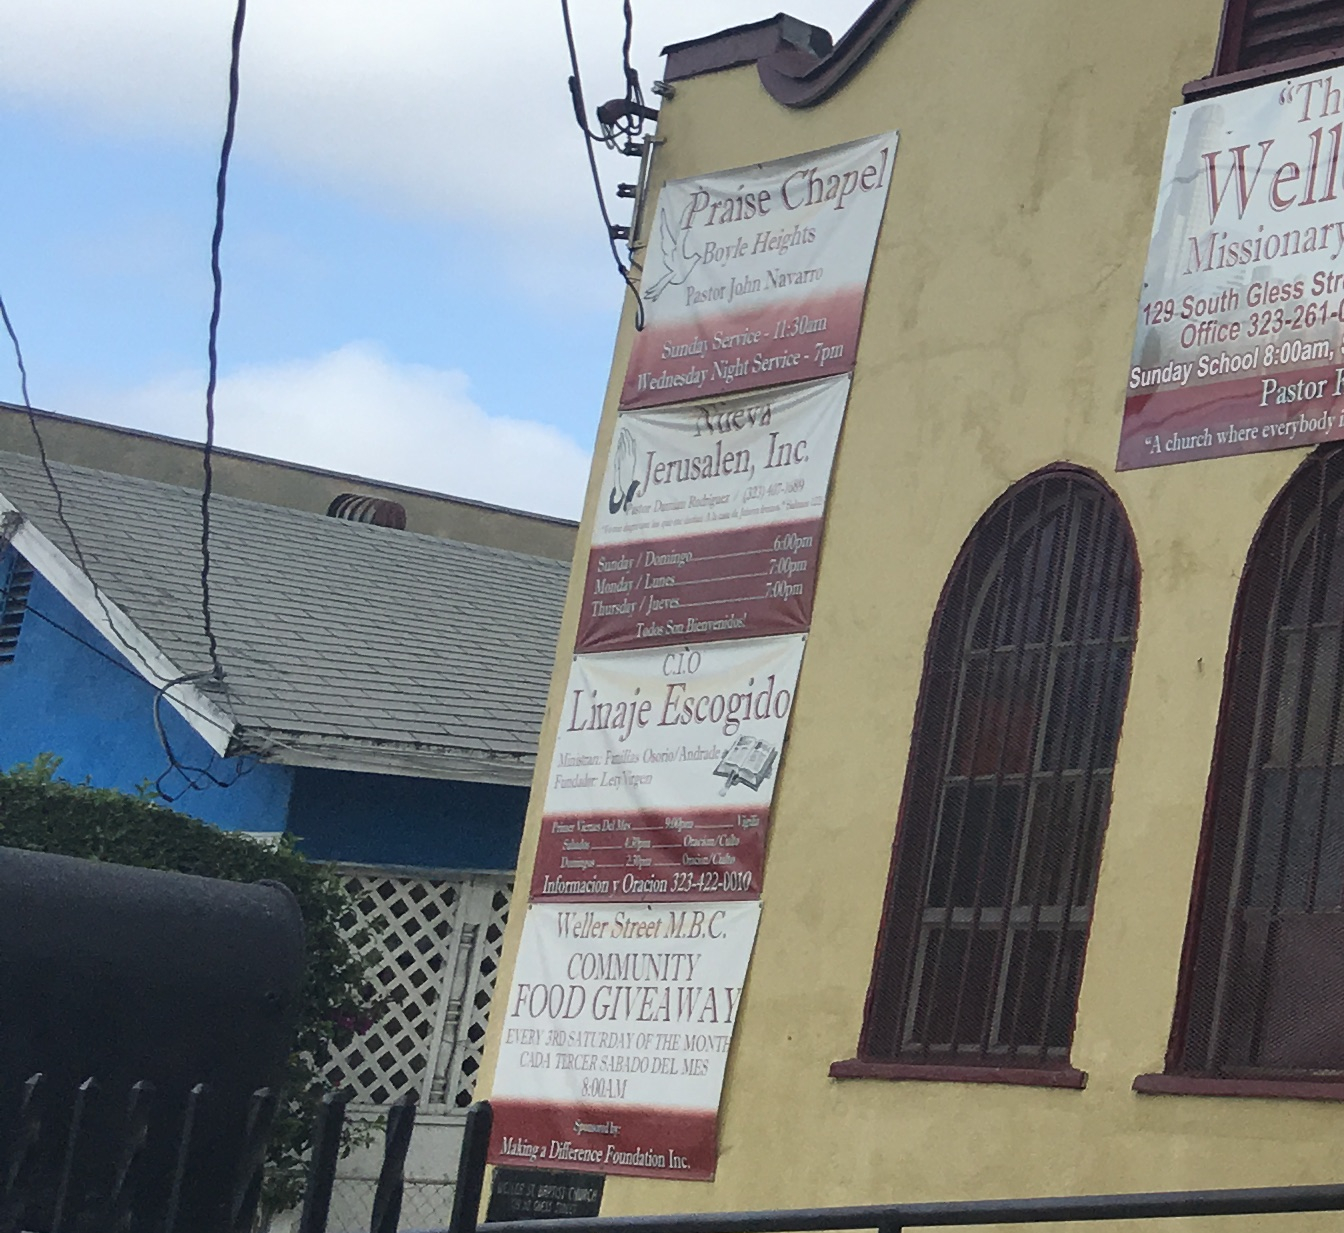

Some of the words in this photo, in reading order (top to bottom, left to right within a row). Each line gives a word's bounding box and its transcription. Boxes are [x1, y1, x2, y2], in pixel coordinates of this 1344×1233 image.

[681, 184, 771, 230] Praise
[781, 147, 889, 211] Chapel
[702, 237, 749, 267] Boyle
[750, 225, 817, 256] Heights
[686, 284, 726, 306] Pastor
[728, 274, 761, 303] John
[764, 266, 824, 290] Navarro
[1143, 298, 1175, 325] 129
[1180, 288, 1239, 320] South
[1246, 280, 1305, 307] Gless
[661, 335, 708, 360] Sunday
[712, 327, 761, 351] Service
[772, 315, 827, 341] 11:30am
[1180, 319, 1241, 348] Office
[637, 365, 708, 392] Wednesday
[710, 357, 750, 384] Night
[750, 350, 801, 376] Service
[814, 342, 845, 366] 7pm
[1129, 358, 1194, 388] Sunday
[1197, 345, 1259, 378] School
[1263, 338, 1335, 367] 8:00am,
[1259, 378, 1329, 407] Pastor
[1165, 428, 1213, 452] church
[1216, 424, 1260, 446] where
[1262, 410, 1336, 440] everybody
[636, 440, 755, 498] Jerusalen,
[763, 431, 810, 471] Inc.
[597, 555, 634, 574] Sunday
[644, 549, 693, 568] Domingo
[773, 533, 813, 554] 6:00pm
[593, 578, 634, 596] Monday
[644, 574, 675, 590] Lunes
[769, 557, 808, 578] 7:00pm
[591, 600, 638, 618] Thursday
[645, 595, 681, 615] Jueves
[765, 581, 804, 601] 7:00pm
[636, 622, 665, 638] Todos
[567, 687, 653, 743] Linaje
[657, 674, 790, 736] Escogido
[542, 874, 609, 894] Informacion
[609, 881, 619, 898] y
[622, 873, 667, 894] Oracion
[670, 870, 753, 893] 323-422-0010
[557, 911, 609, 939] Weller
[610, 910, 663, 940] Street
[664, 909, 728, 940] M.B.C.
[567, 952, 702, 982] COMMUNITY
[511, 983, 586, 1020] FOOD
[592, 984, 744, 1024] GIVEAWAY
[505, 1027, 542, 1046] EVERY
[545, 1030, 567, 1047] 3RD
[567, 1030, 635, 1050] SATURDAY
[636, 1032, 654, 1050] OF
[655, 1033, 682, 1051] THE
[682, 1033, 732, 1054] MONTH
[519, 1050, 551, 1069] CADA
[555, 1052, 598, 1071] TERCER
[599, 1054, 650, 1073] SABADO
[651, 1056, 679, 1075] DEL
[681, 1057, 710, 1077] MES
[581, 1076, 628, 1099] 8:00AM
[500, 1136, 539, 1162] Making
[540, 1146, 547, 1158] a
[549, 1140, 603, 1163] Difference
[604, 1144, 666, 1168] Foundation
[668, 1148, 691, 1169] Inc.
